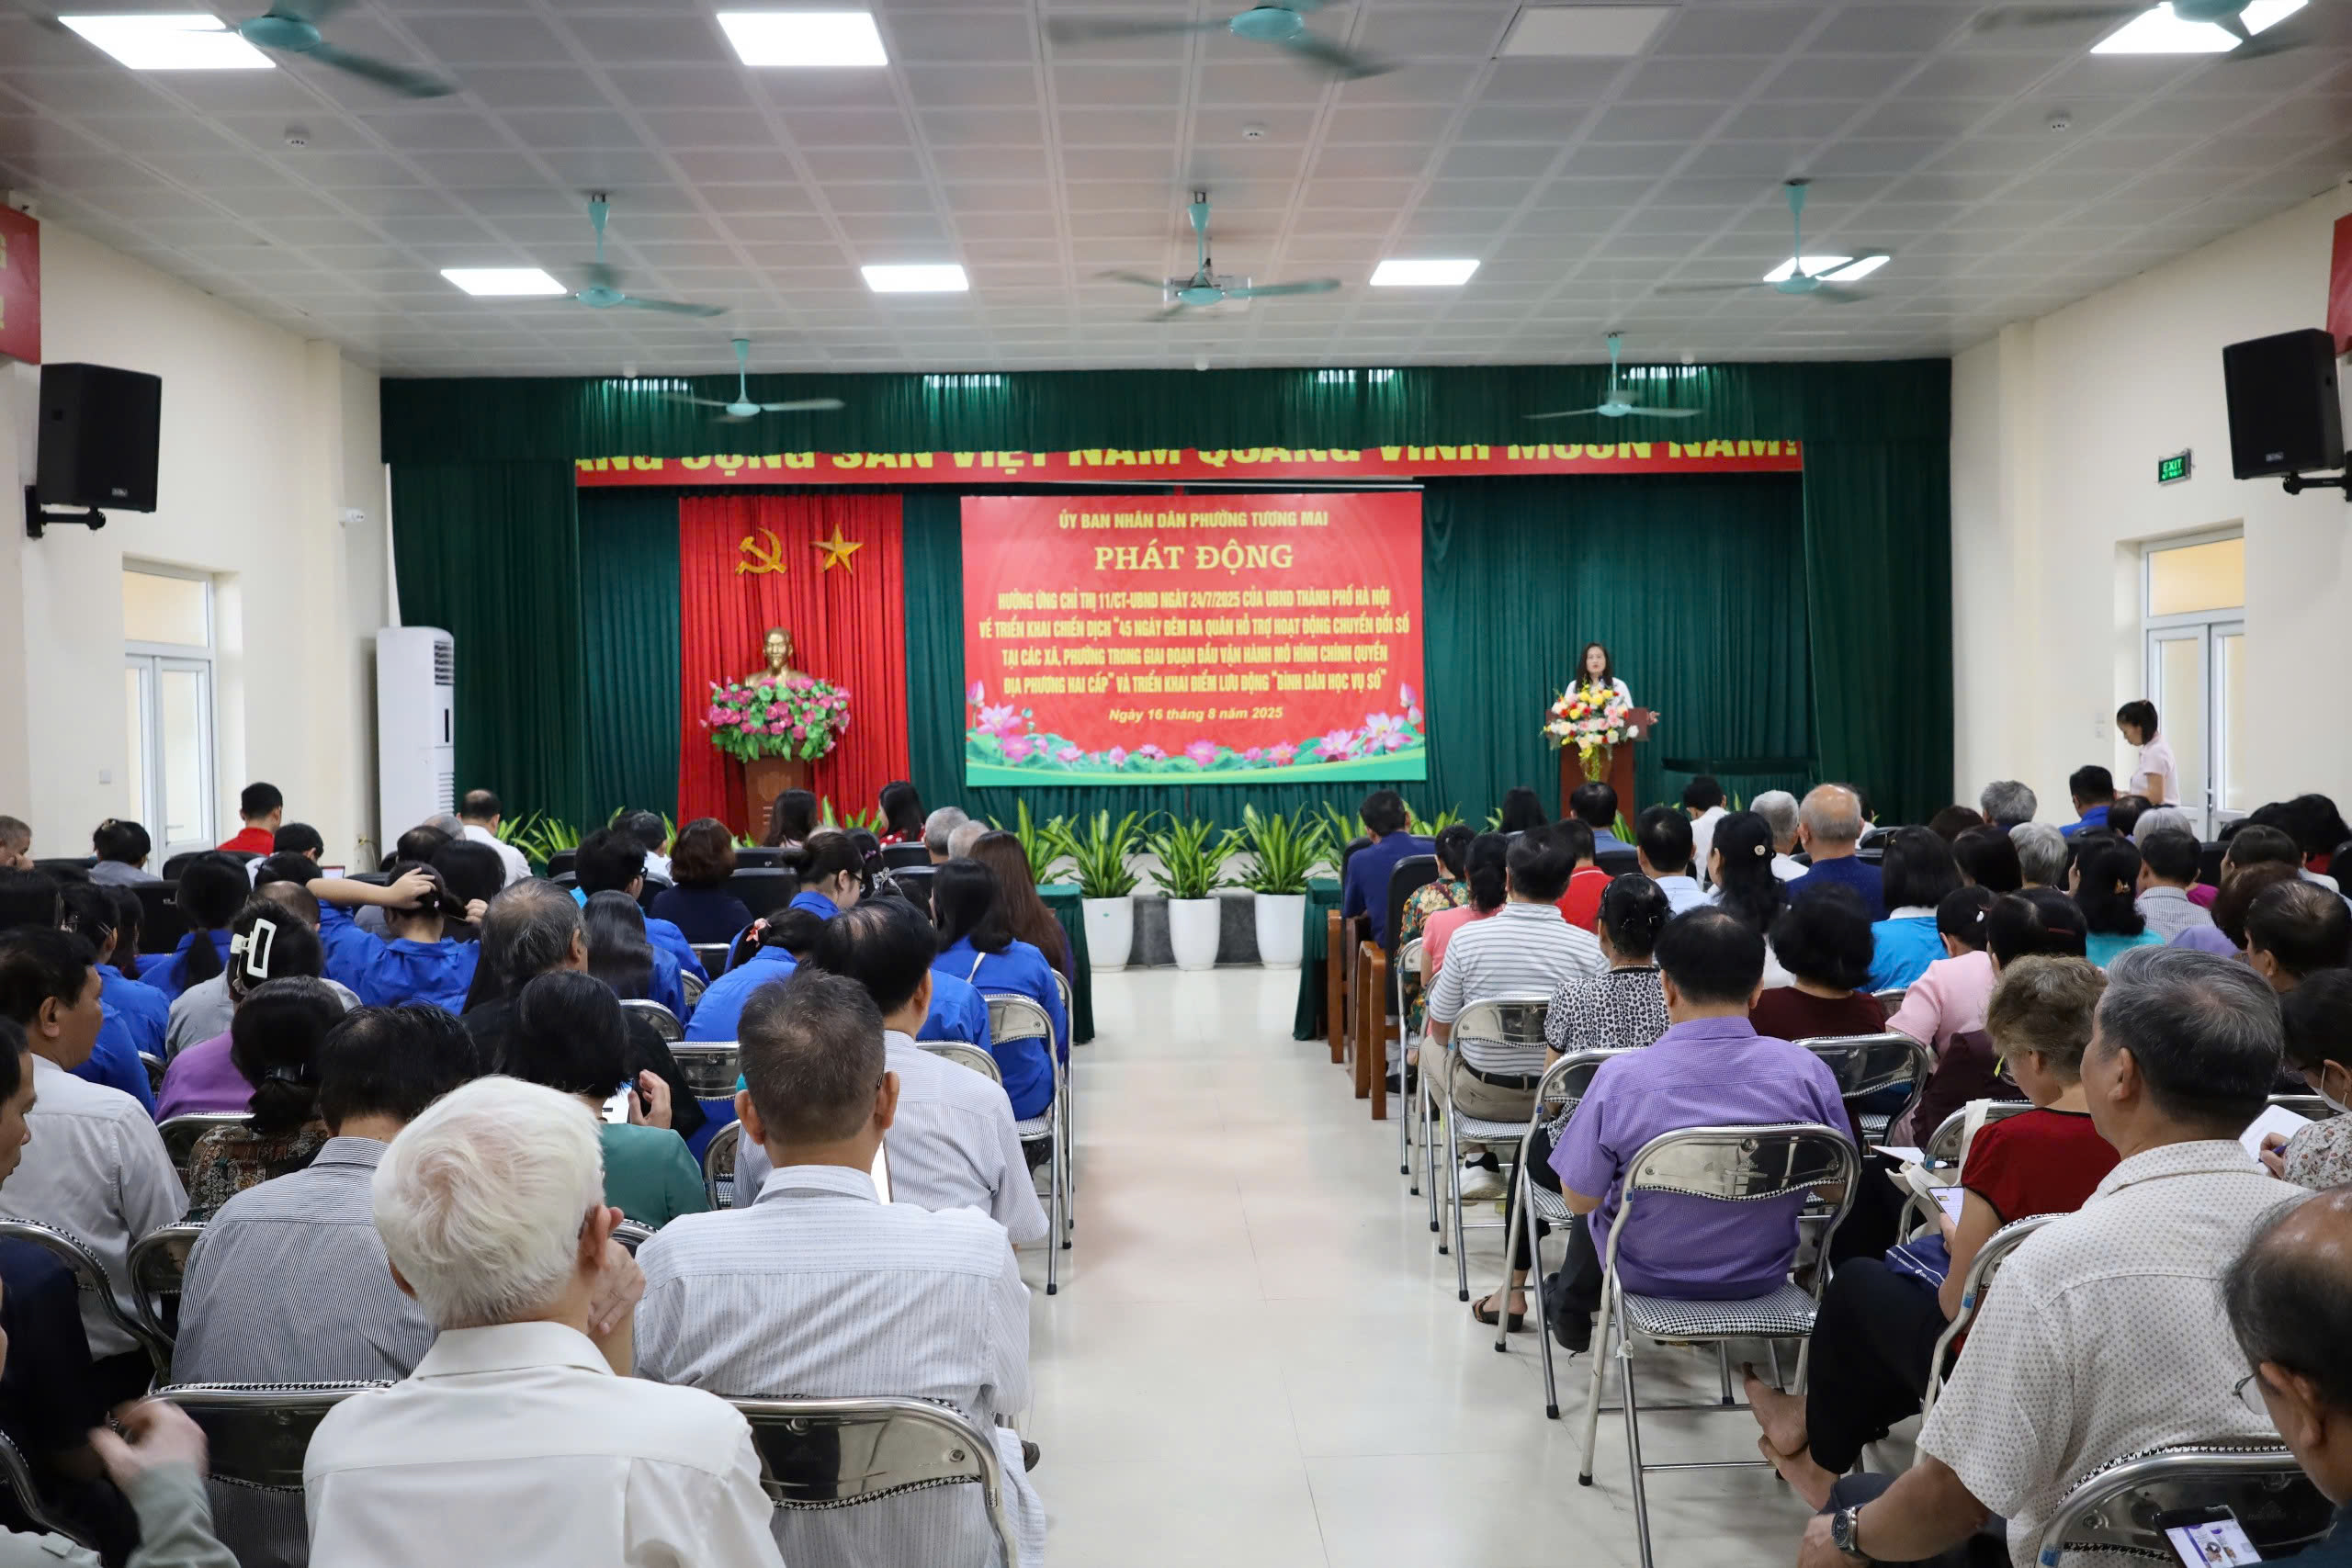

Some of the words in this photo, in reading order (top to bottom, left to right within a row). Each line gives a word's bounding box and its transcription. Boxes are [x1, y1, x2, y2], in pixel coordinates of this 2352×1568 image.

[2163, 458, 2183, 472] EXIT
[1059, 510, 1076, 529] ỦY
[1081, 513, 1110, 529] BAN
[1114, 511, 1153, 528] NHÂN
[1158, 511, 1186, 528] DÂN
[1191, 510, 1247, 527] PHƯỜNG
[1252, 511, 1297, 527] TƯƠNG
[1301, 511, 1329, 525] MAI
[1095, 538, 1183, 570] PHÁT
[1196, 539, 1293, 575] ĐỘNG
[1191, 591, 1239, 608] 24/7/2025
[1109, 709, 1143, 723] Ngày
[1148, 708, 1163, 720] 16
[1167, 709, 1204, 722] tháng
[1208, 708, 1216, 719] 8
[1220, 708, 1248, 719] năm
[1252, 706, 1283, 718] 2025
